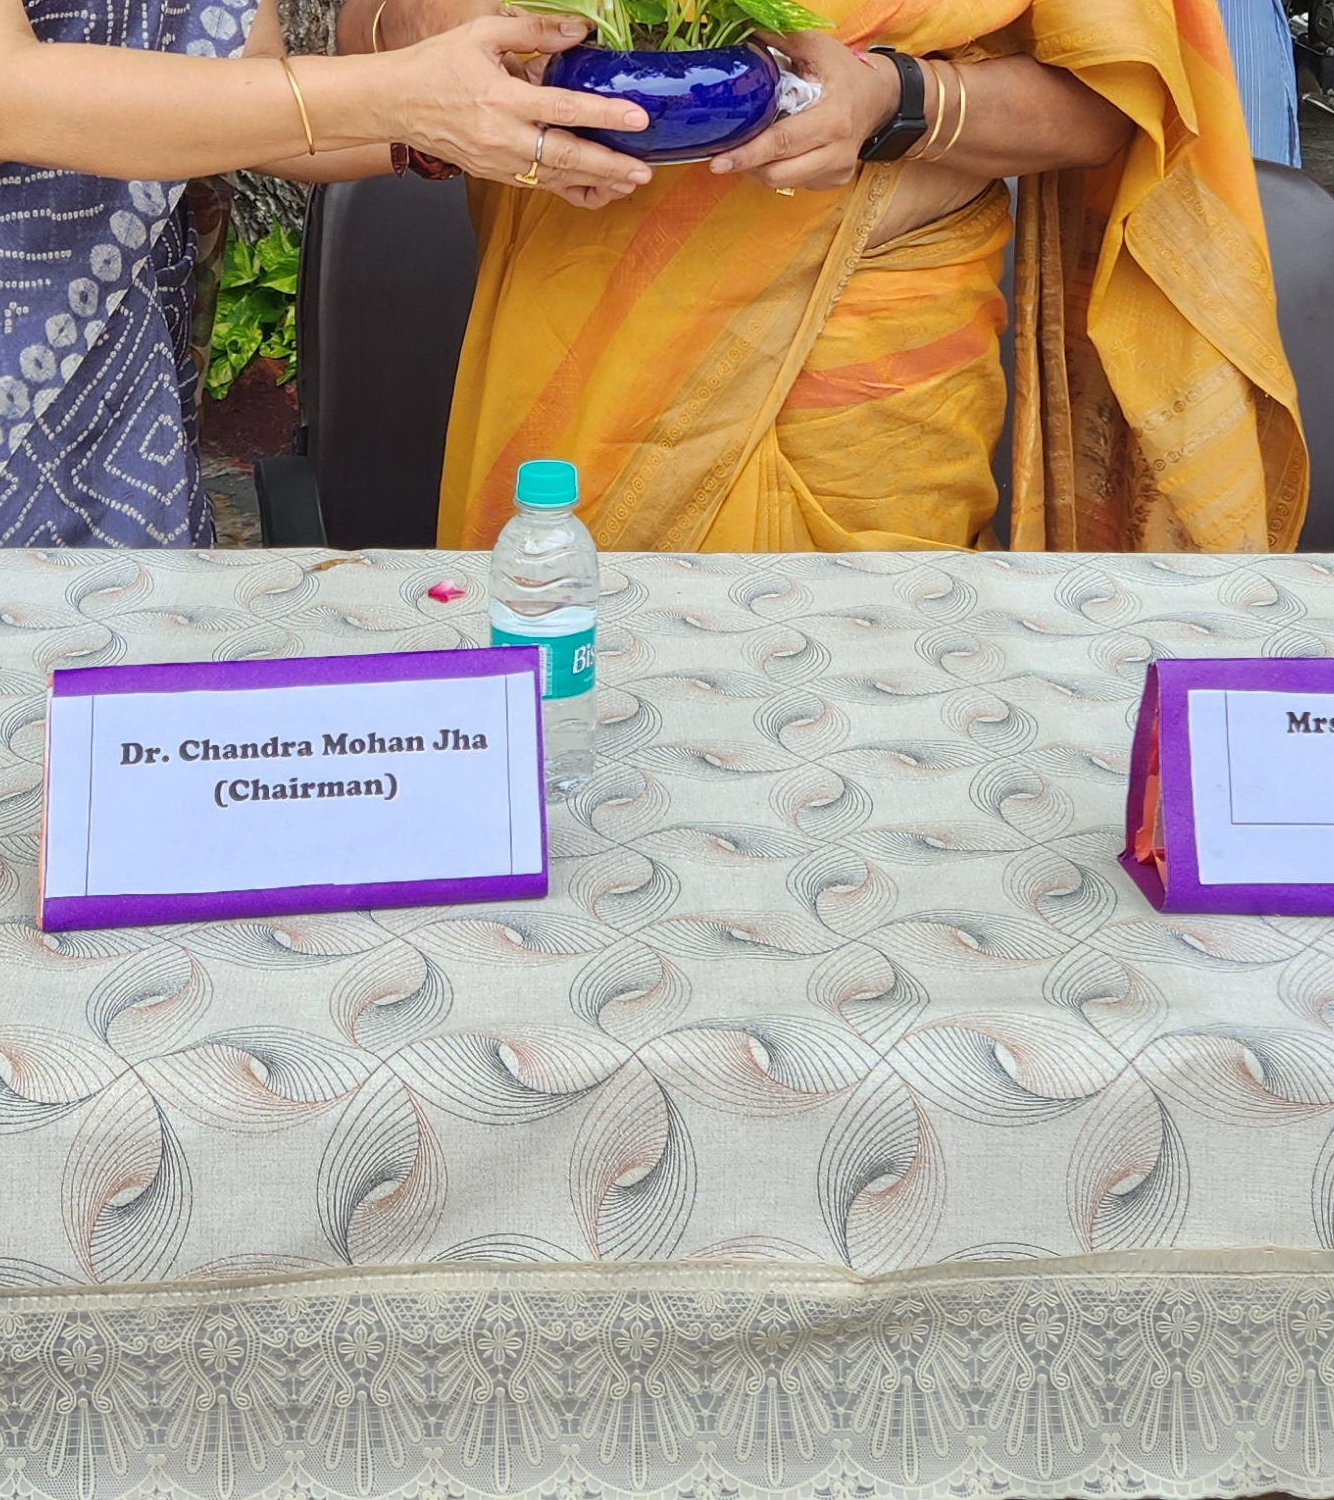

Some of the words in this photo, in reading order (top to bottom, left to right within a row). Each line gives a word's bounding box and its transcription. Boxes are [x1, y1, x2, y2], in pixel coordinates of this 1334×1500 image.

[120, 742, 170, 765] Dr.
[179, 736, 314, 761] Chandra
[322, 732, 424, 756] Mohan
[432, 729, 488, 751] Jha
[214, 773, 397, 808] (Chairman)
